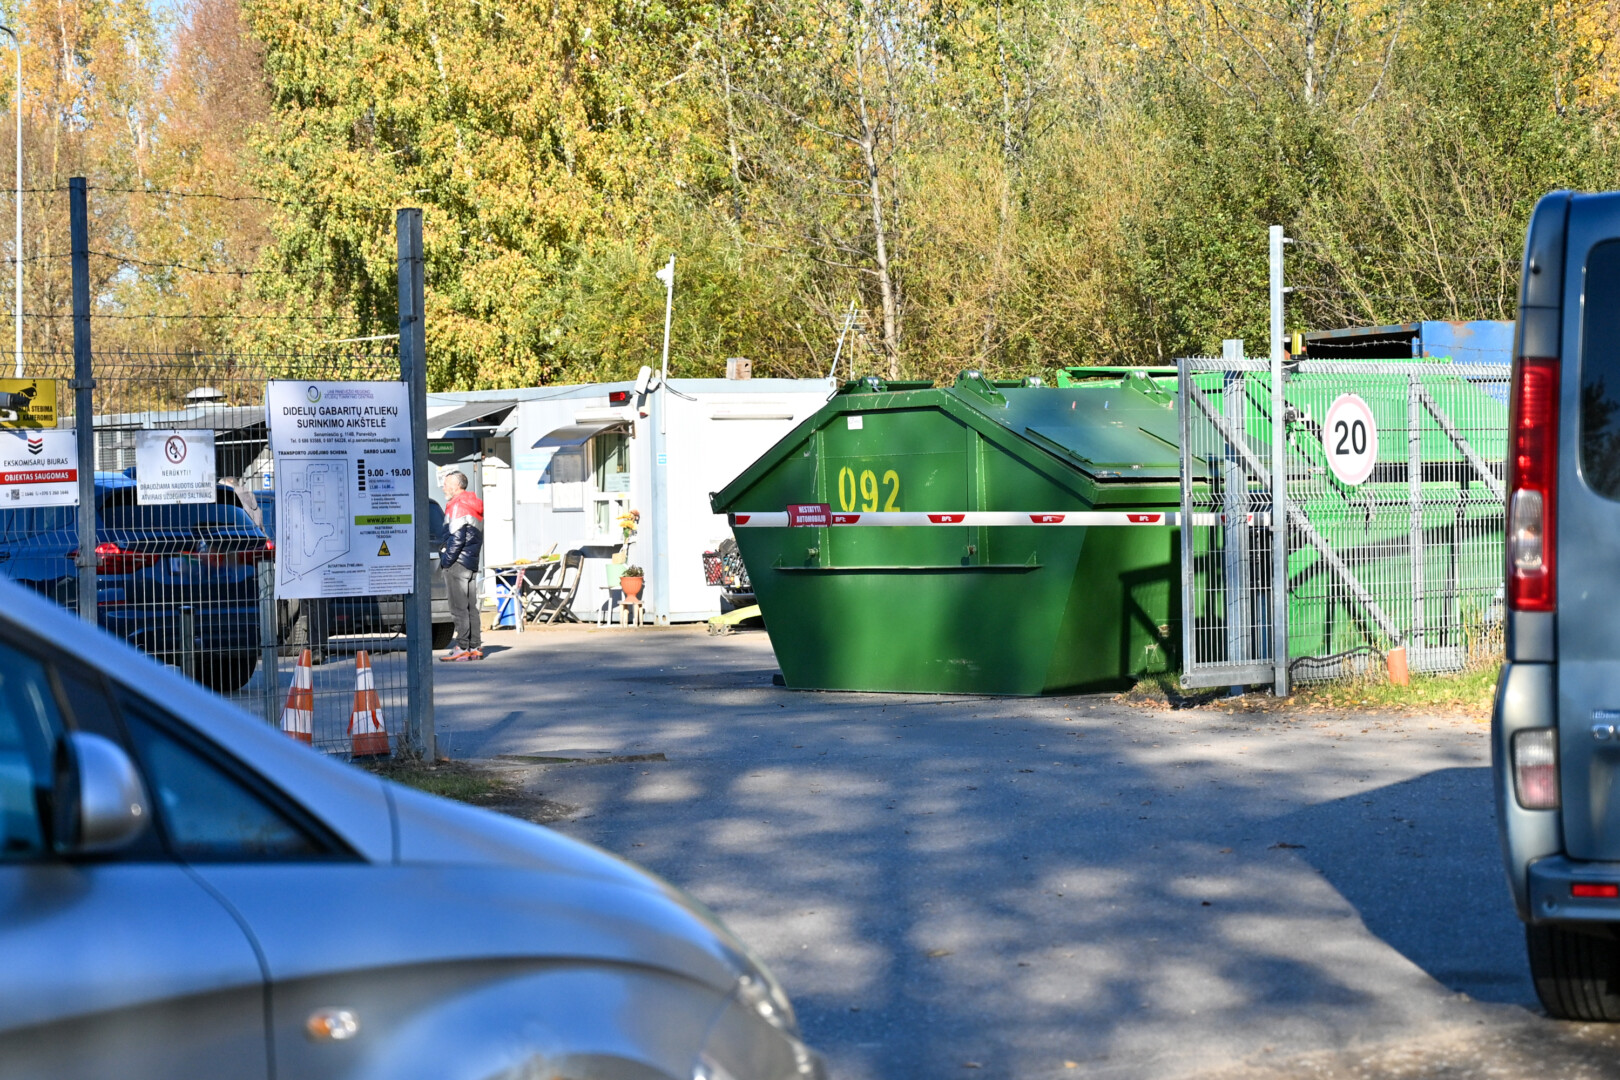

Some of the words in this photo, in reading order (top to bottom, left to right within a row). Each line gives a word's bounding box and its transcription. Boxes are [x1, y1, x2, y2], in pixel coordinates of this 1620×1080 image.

[283, 407, 316, 417] DIDELIŲ
[319, 406, 362, 417] GABARITŲ
[364, 406, 398, 416] ATLIEKŲ
[297, 419, 344, 428] SURINKIMO
[346, 416, 386, 428] AIKŠTELĖ
[1335, 420, 1366, 455] 20
[4, 459, 45, 468] EKSKOMISARŲ
[5, 473, 33, 481] OBJEKTAS
[35, 472, 68, 480] SAUGOMAS
[140, 482, 170, 490] DRAUDŽIAMA
[838, 466, 900, 512] 092
